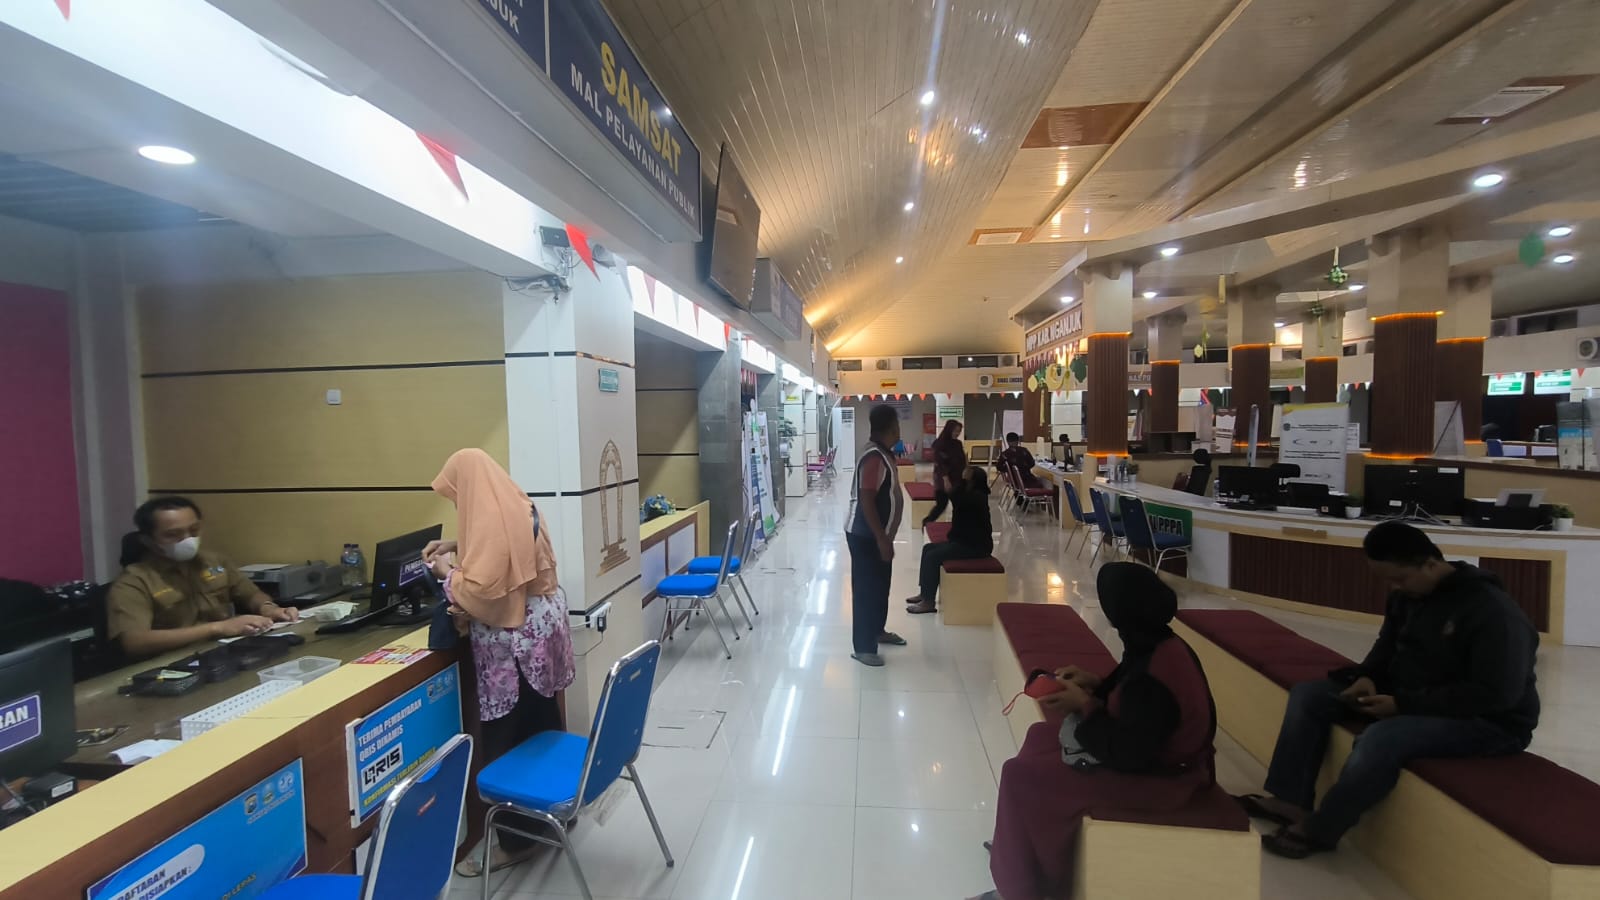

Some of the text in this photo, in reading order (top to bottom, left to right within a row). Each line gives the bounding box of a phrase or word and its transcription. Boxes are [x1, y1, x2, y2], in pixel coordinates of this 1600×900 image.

[571, 62, 695, 219] MAL PELAYANAN PUBLIK
[601, 41, 681, 176] SAMSAT
[358, 723, 384, 747] TERIMA
[364, 747, 400, 785] QRIS
